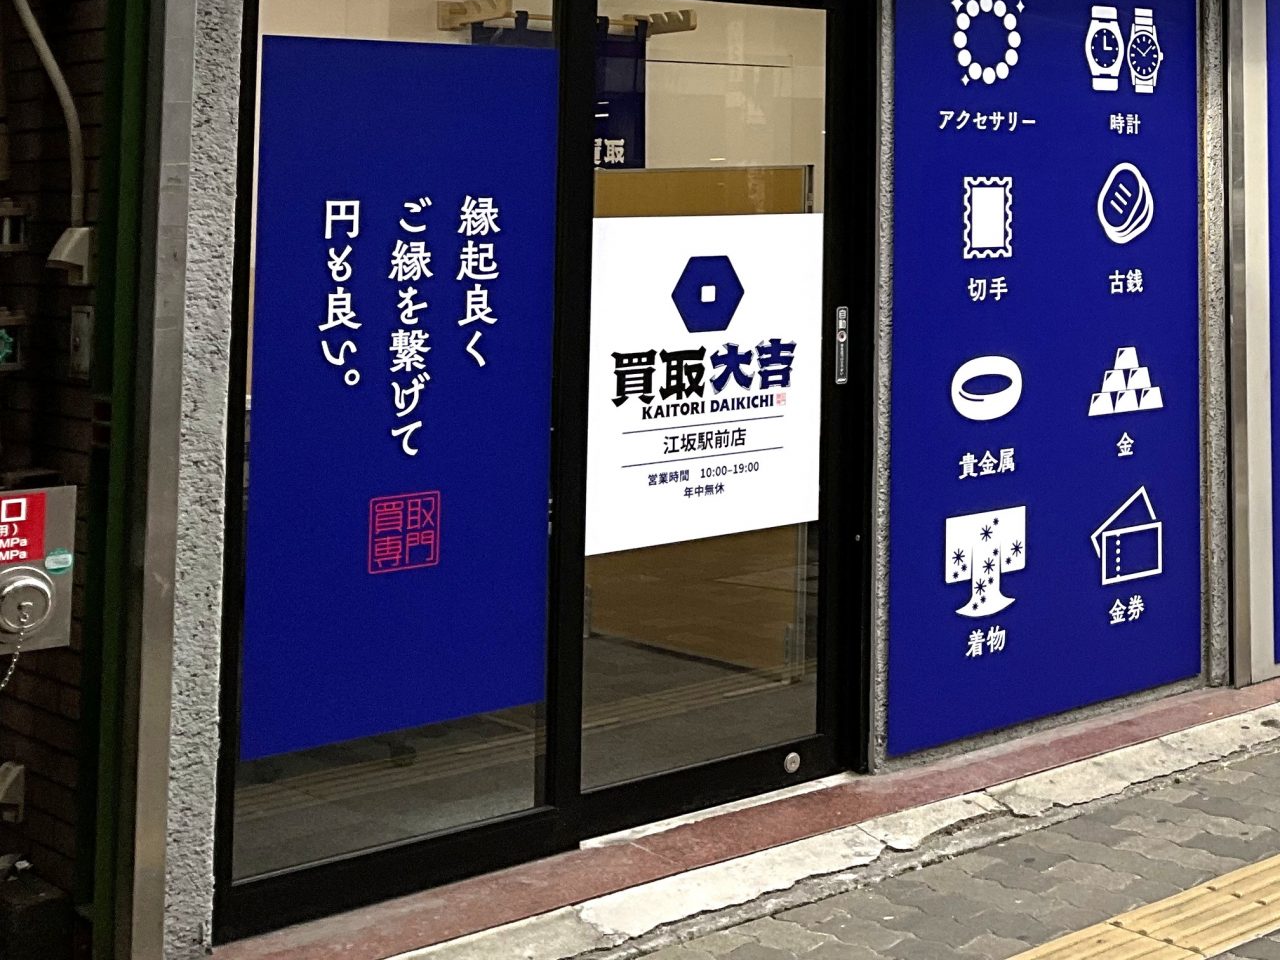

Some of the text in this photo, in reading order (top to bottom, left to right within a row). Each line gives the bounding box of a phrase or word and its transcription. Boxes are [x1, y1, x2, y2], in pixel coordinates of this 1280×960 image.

[938, 109, 1142, 136] アクセサリー 時計
[318, 198, 362, 388] 円も良い。
[456, 194, 501, 370] 縁起良く
[967, 269, 1144, 303] 切手 古銭
[388, 196, 433, 457] ご縁を繋げて
[610, 338, 797, 408] 買取大吉
[642, 401, 706, 420] KAITORI
[710, 394, 774, 413] DAIKICHI
[663, 427, 747, 455] 江坂駅前店
[958, 432, 1136, 479] 貴金属 金
[648, 469, 690, 487] 営業時間
[683, 482, 725, 499] 年中無休
[966, 595, 1145, 658] 着物 金券
